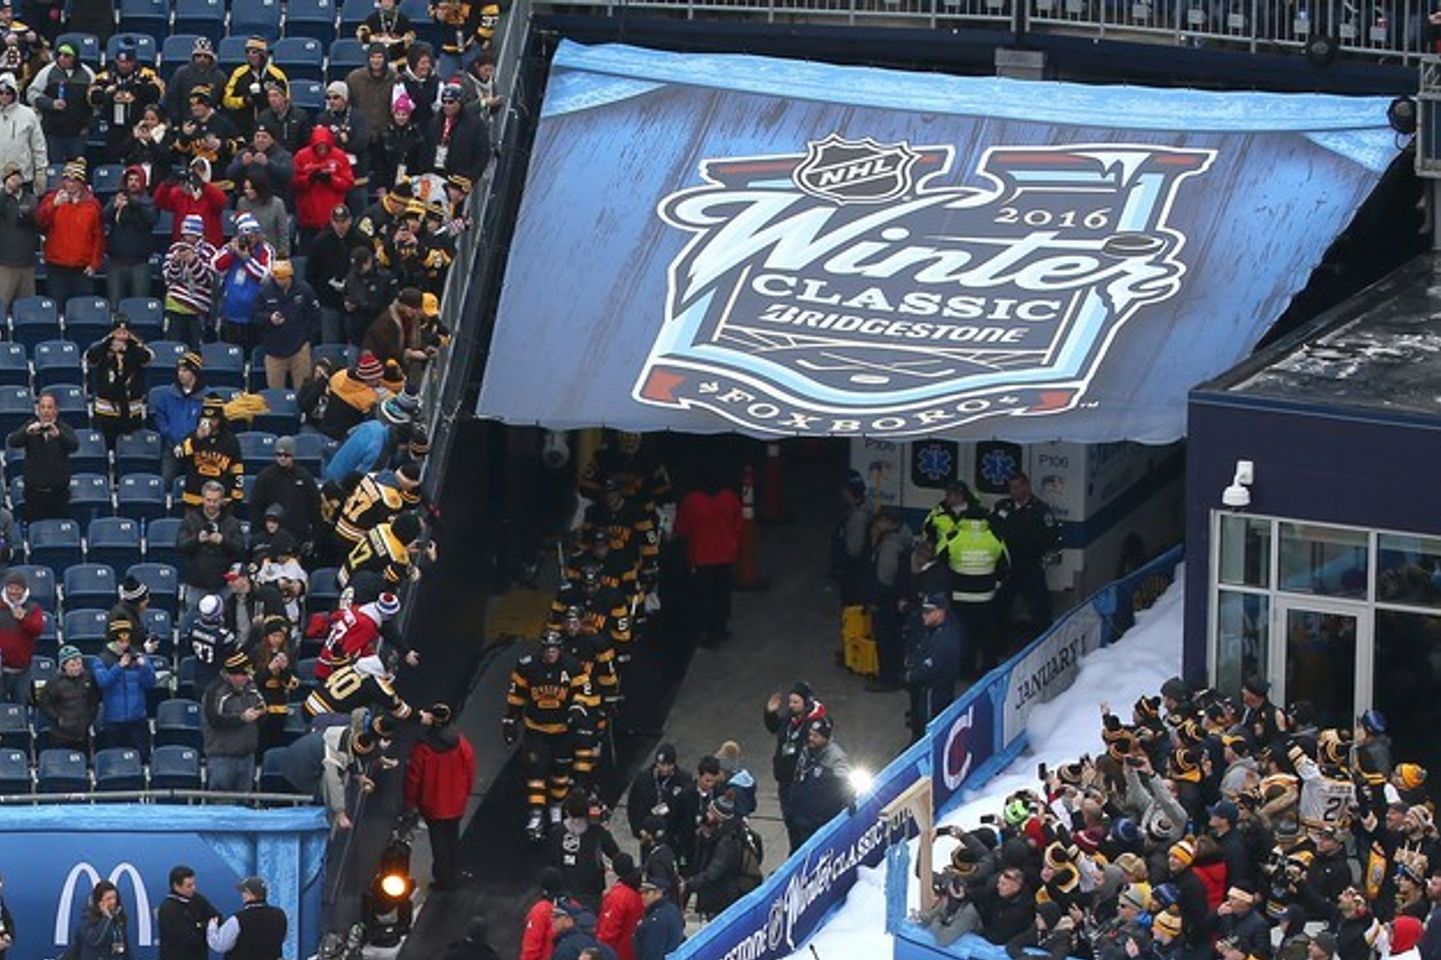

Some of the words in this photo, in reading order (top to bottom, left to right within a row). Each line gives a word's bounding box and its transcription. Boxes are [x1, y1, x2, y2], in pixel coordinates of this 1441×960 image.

[818, 157, 894, 187] NHL
[994, 205, 1110, 229] 2016
[675, 187, 1176, 305] Winter
[752, 273, 1062, 322] CLASSIC
[758, 304, 1029, 346] BRIDGESTONE
[716, 386, 992, 433] FOXBORO
[1015, 638, 1082, 711] JANUARY
